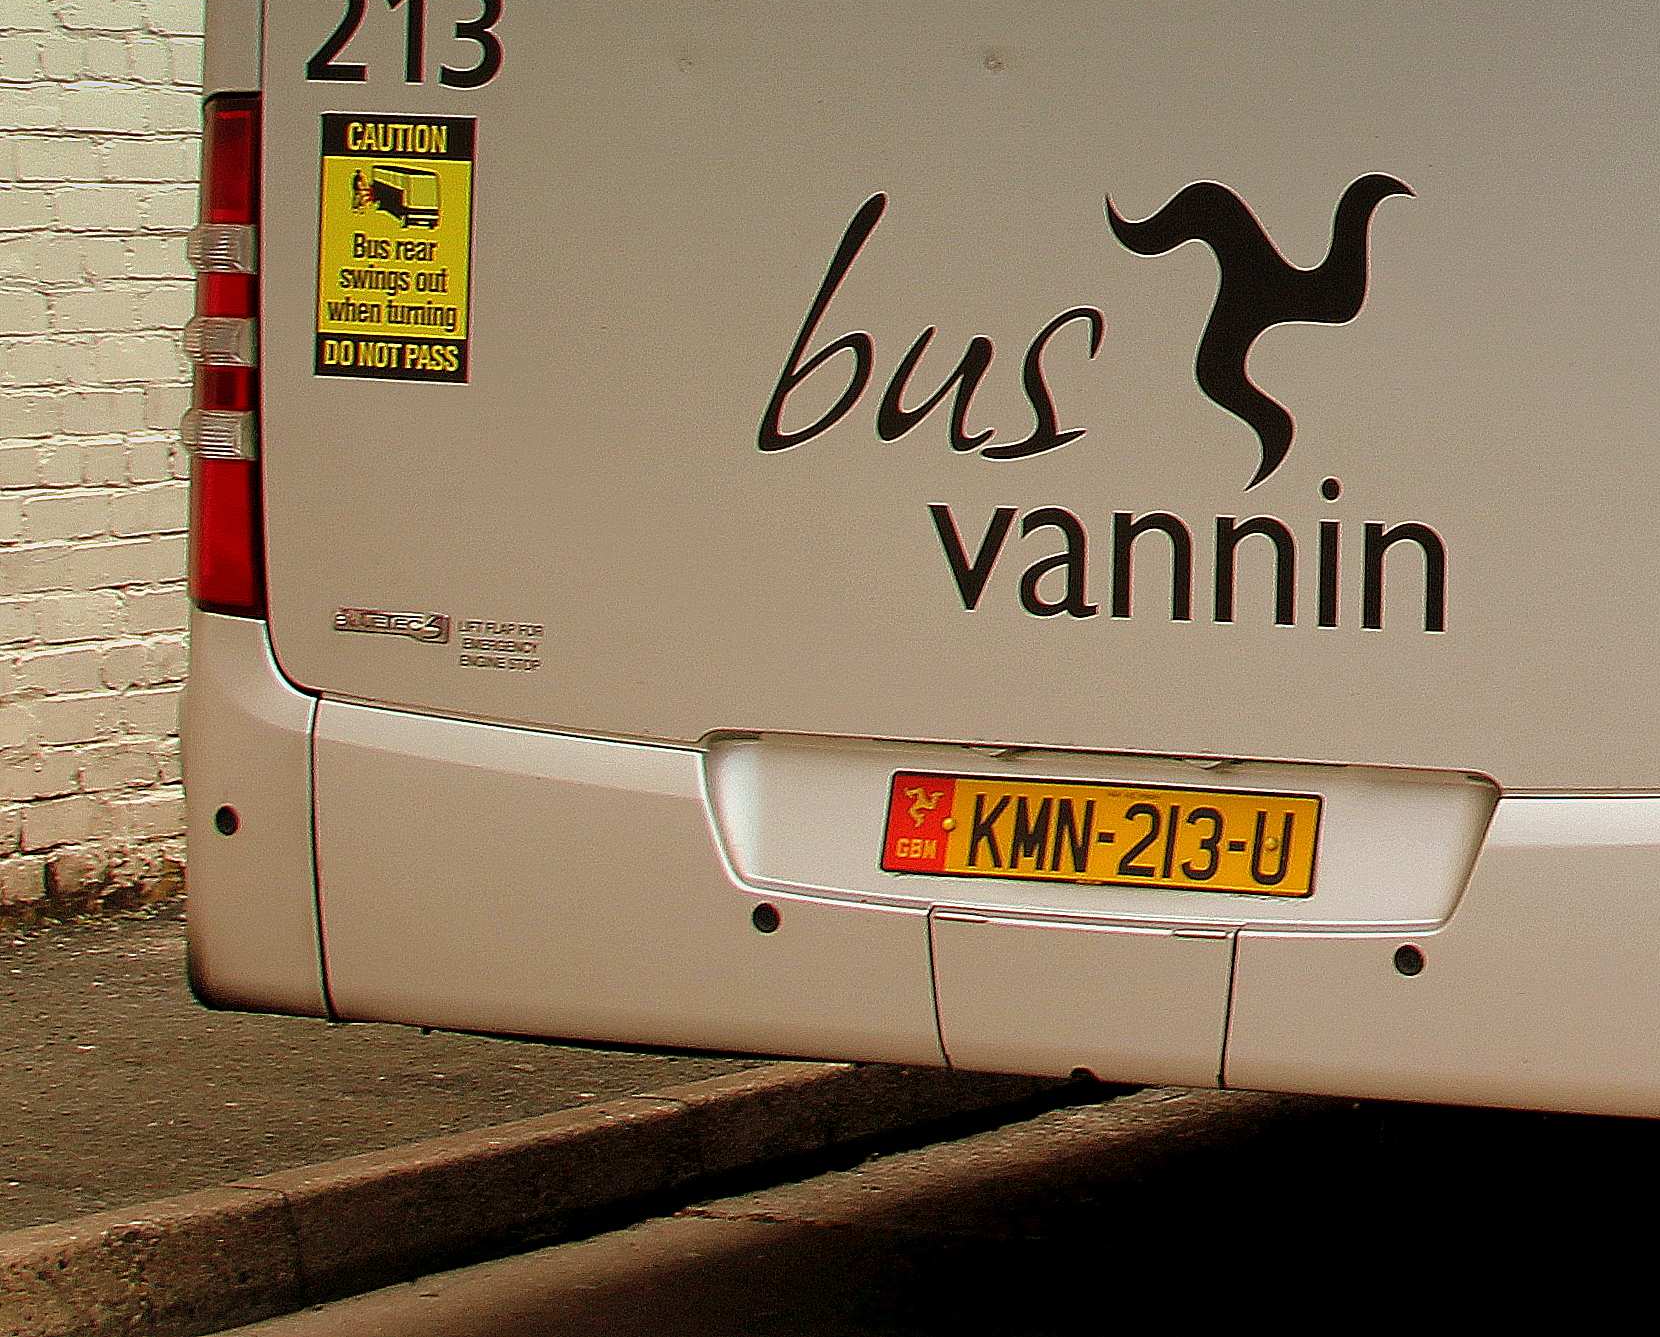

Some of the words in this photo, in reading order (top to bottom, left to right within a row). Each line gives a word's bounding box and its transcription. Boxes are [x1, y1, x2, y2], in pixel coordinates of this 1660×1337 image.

[347, 122, 448, 153] CAUTION
[353, 233, 389, 260] Bus
[395, 238, 437, 262] rear
[340, 264, 410, 295] swings
[416, 267, 448, 293] out
[327, 296, 381, 324] when
[387, 300, 459, 333] turning
[757, 190, 1106, 460] bus
[323, 339, 354, 367] DO
[358, 342, 401, 369] NOT
[406, 344, 460, 372] PASS
[928, 475, 1449, 634] vannin
[967, 793, 1294, 886] KMN-213-U
